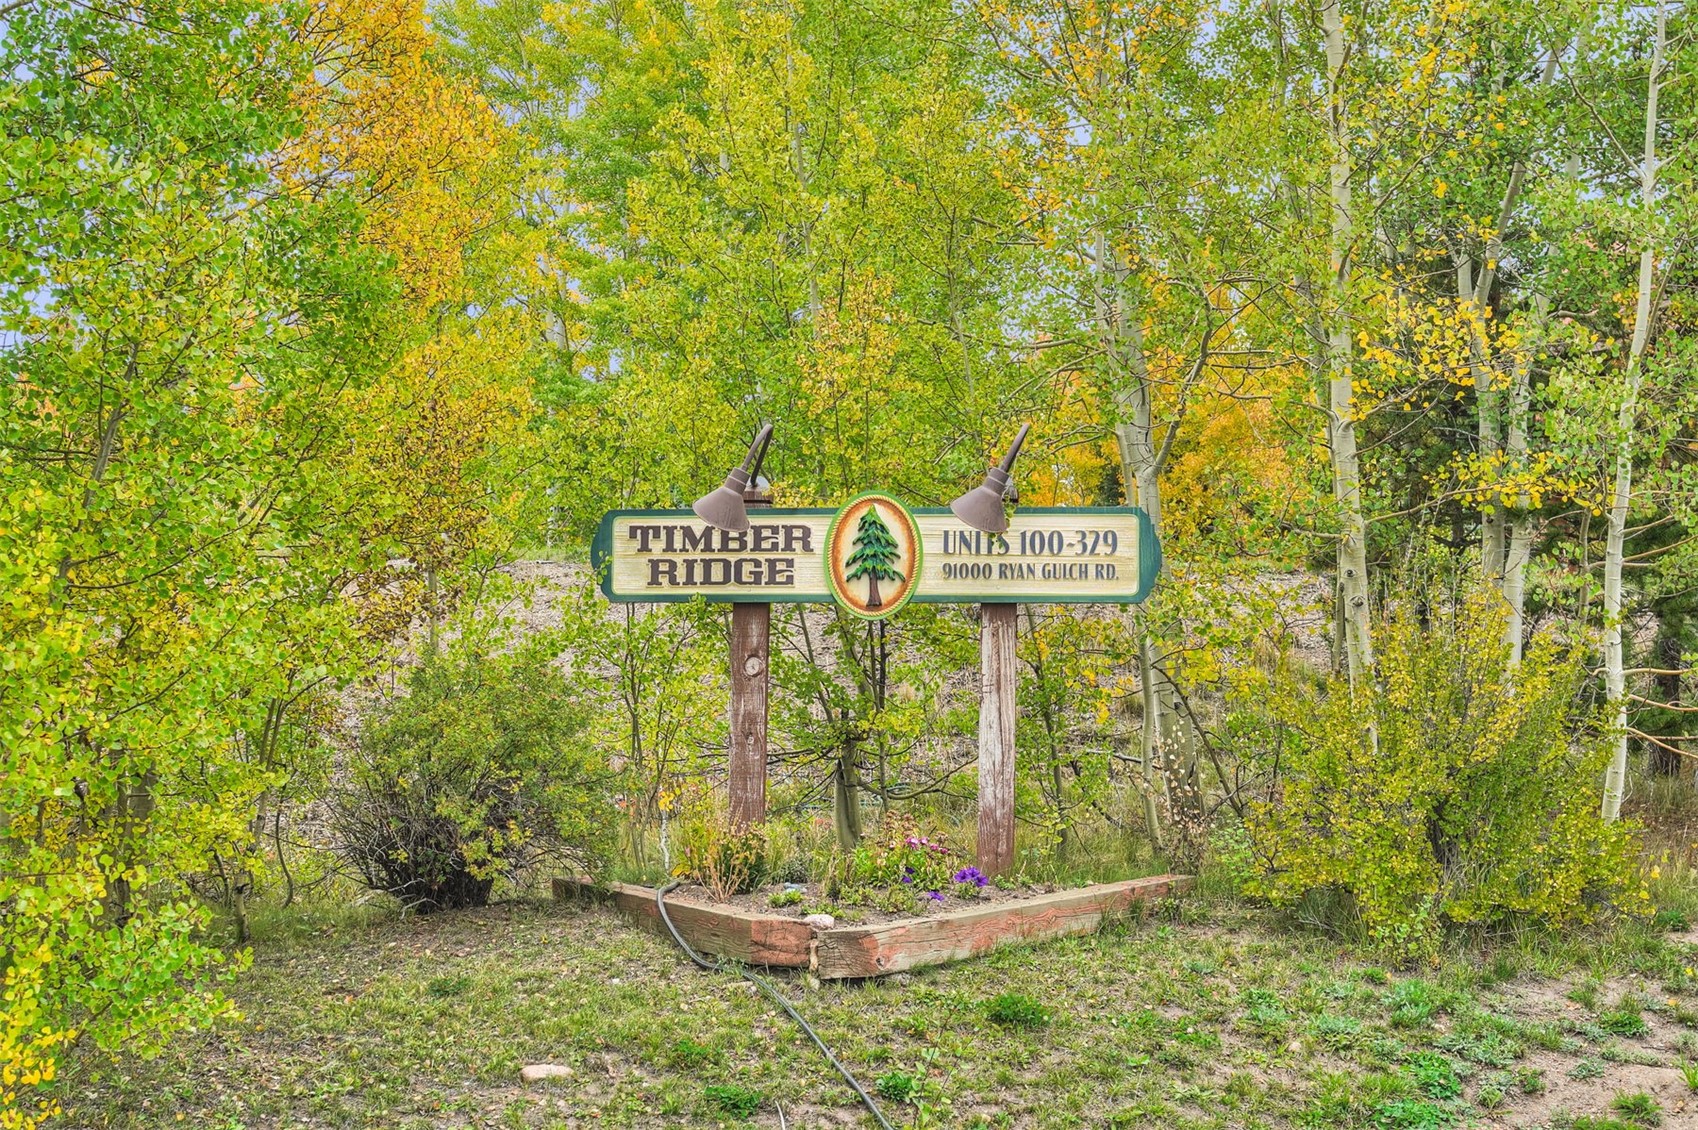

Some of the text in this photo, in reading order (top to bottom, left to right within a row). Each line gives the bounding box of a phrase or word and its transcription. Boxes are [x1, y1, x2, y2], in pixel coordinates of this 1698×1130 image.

[628, 525, 814, 552] TIMBER
[647, 558, 795, 586] RIDGE
[942, 562, 1119, 580] 91000 RYAN GULCH RD.
